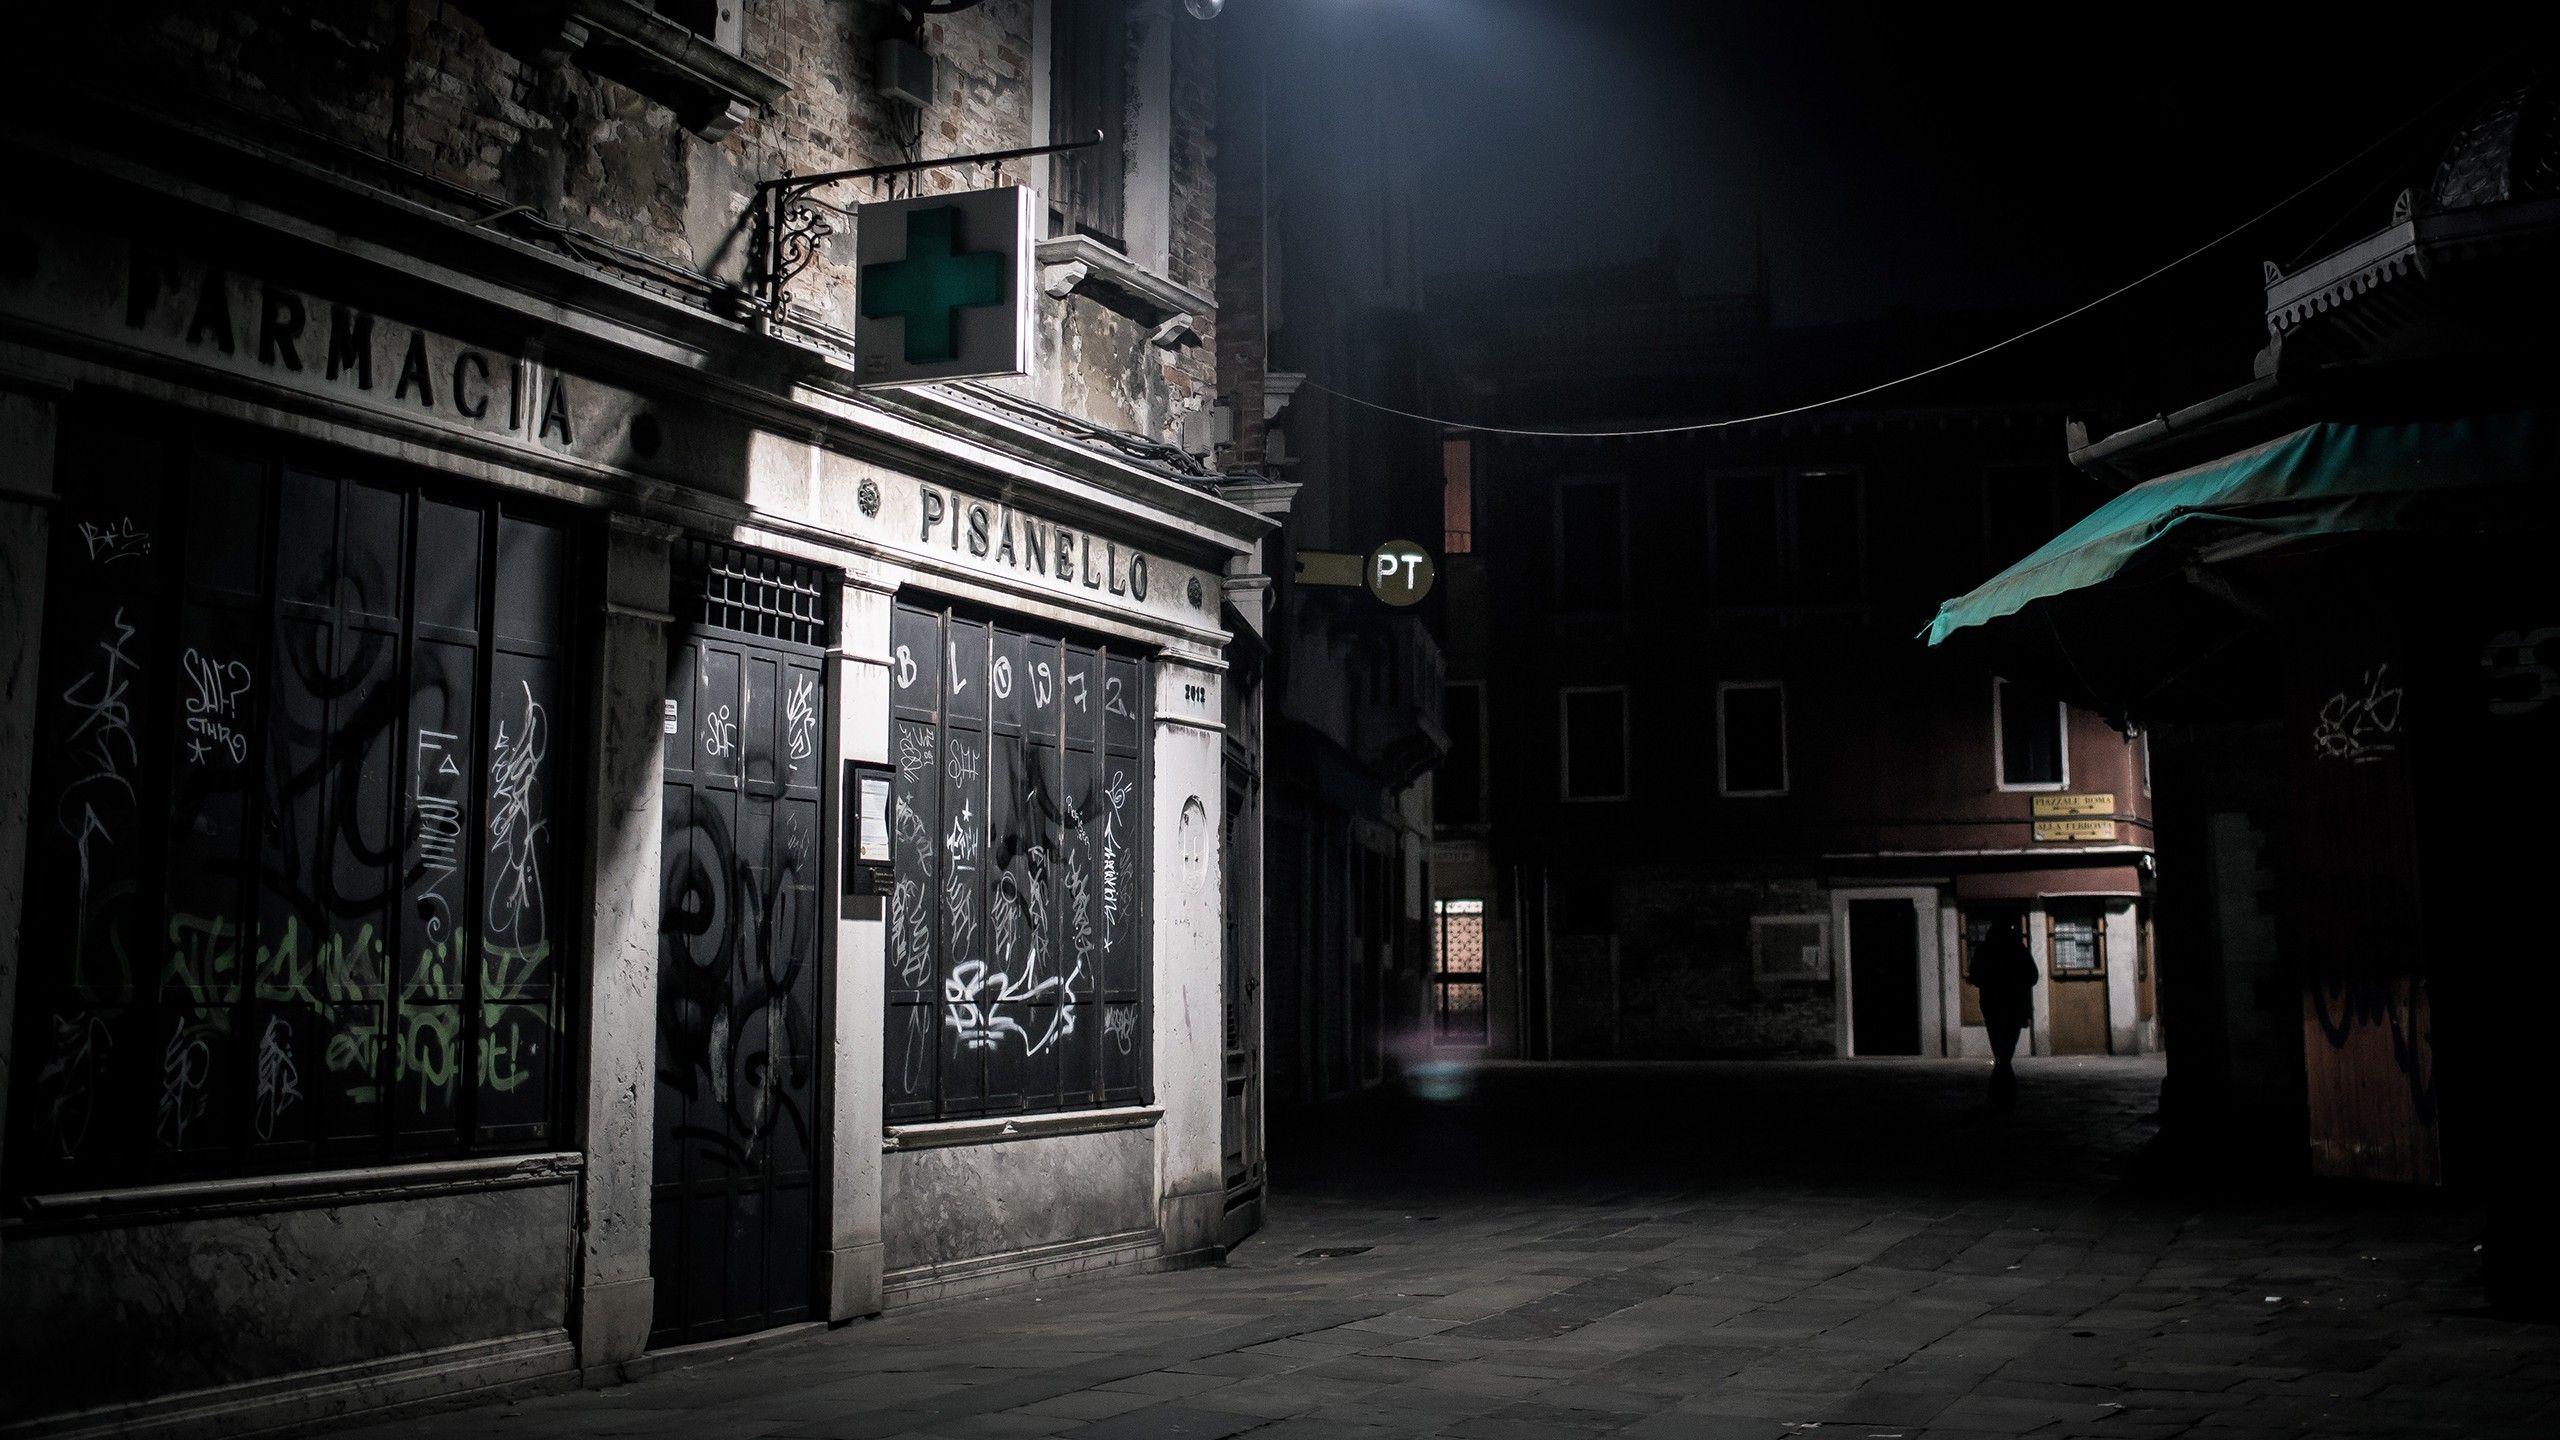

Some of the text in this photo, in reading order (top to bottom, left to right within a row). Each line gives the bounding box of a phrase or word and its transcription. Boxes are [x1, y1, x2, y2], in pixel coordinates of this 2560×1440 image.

[124, 243, 573, 446] FARMACIA
[919, 483, 1149, 603] PISANELLO
[1375, 553, 1423, 590] PT
